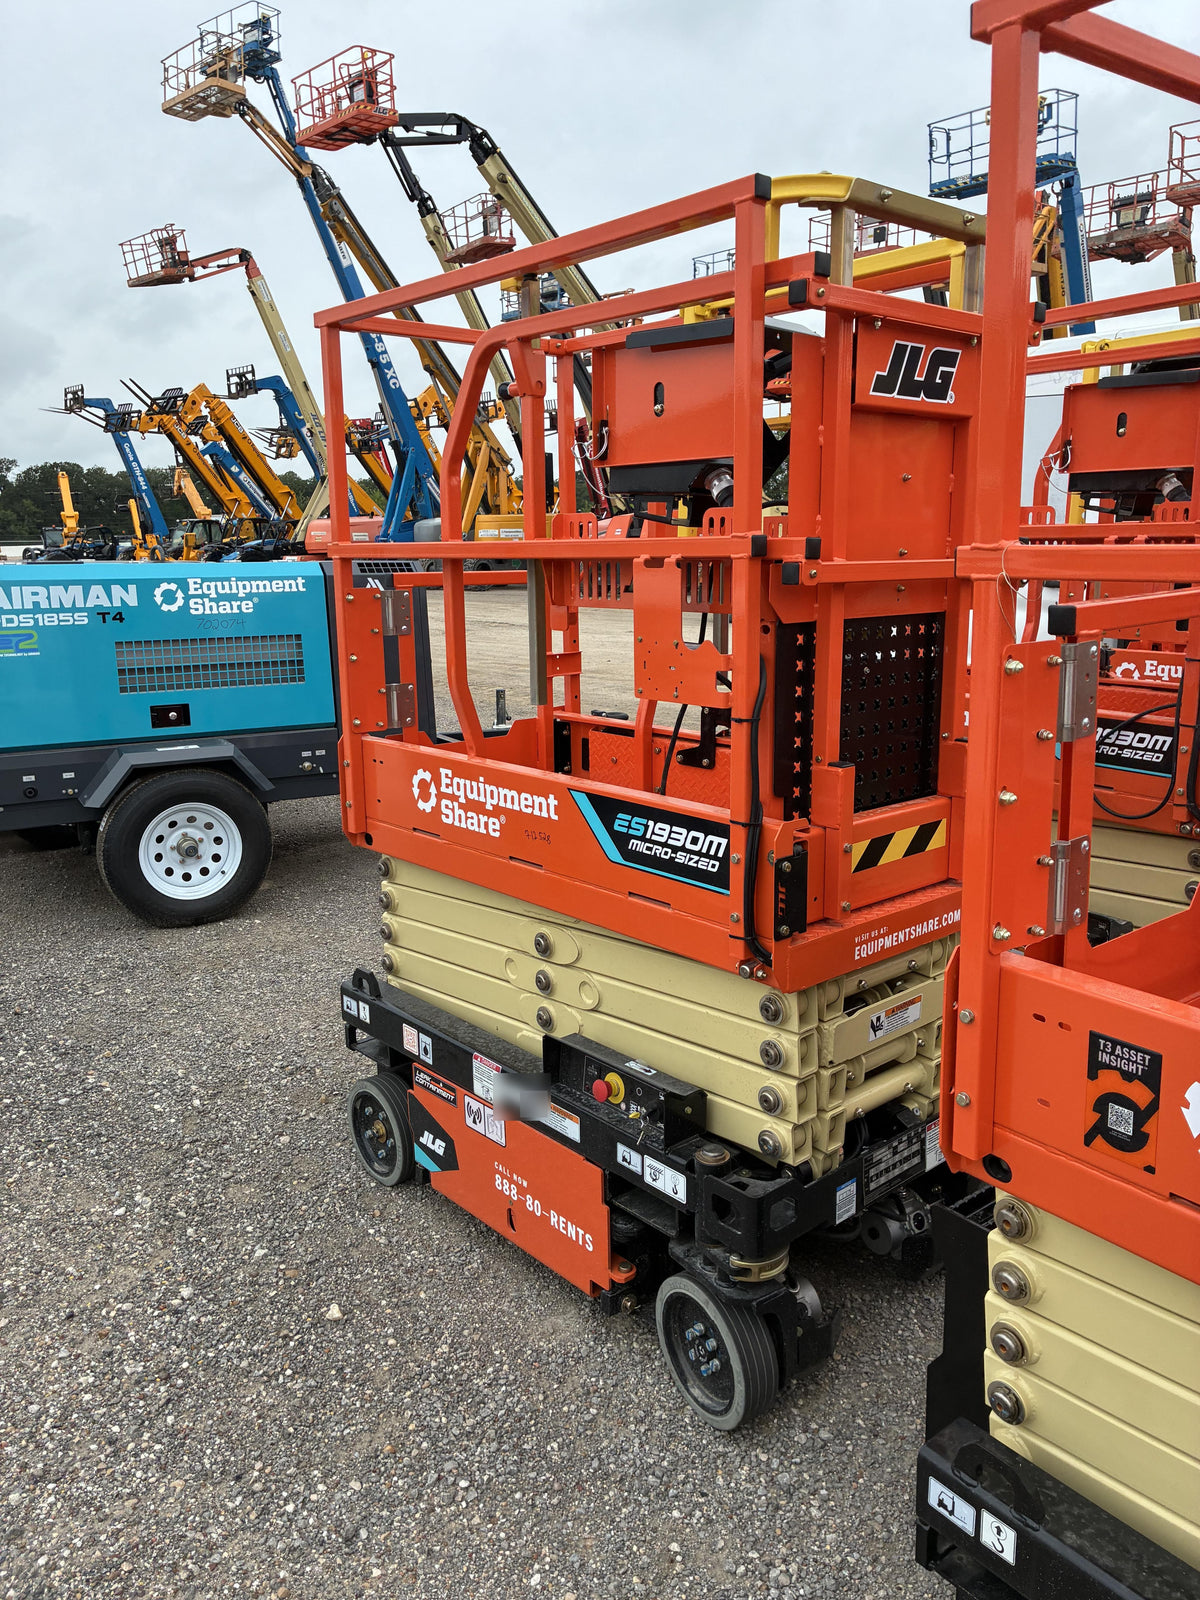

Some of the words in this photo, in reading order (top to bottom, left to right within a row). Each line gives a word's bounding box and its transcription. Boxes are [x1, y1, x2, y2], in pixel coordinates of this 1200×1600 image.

[373, 106, 389, 116] JLG
[384, 367, 400, 390] XC
[870, 340, 962, 404] JLG
[173, 423, 188, 440] JCB
[230, 416, 244, 434] JCB
[123, 442, 134, 462] Genie
[187, 577, 306, 598] Equipment
[0, 612, 89, 628] DS185S
[96, 611, 125, 624] T4
[1097, 745, 1164, 763] RO-SIZED
[439, 767, 559, 821] Equipment
[613, 813, 729, 858] ES1930M
[628, 838, 720, 873] MICRO-SIZED
[854, 908, 961, 961] EQUIPMENTSHARE.COM
[854, 932, 870, 944] VISIT
[871, 930, 879, 938] US
[1098, 1038, 1112, 1053] T3
[1114, 1044, 1151, 1066] ASSET
[415, 1070, 432, 1082] LEAK
[415, 1075, 455, 1102] CONTAINMENT
[419, 1130, 446, 1157] JLG
[494, 1161, 511, 1178] CALL
[512, 1173, 528, 1189] NOW
[494, 1173, 594, 1252] 888-80-RENTS
